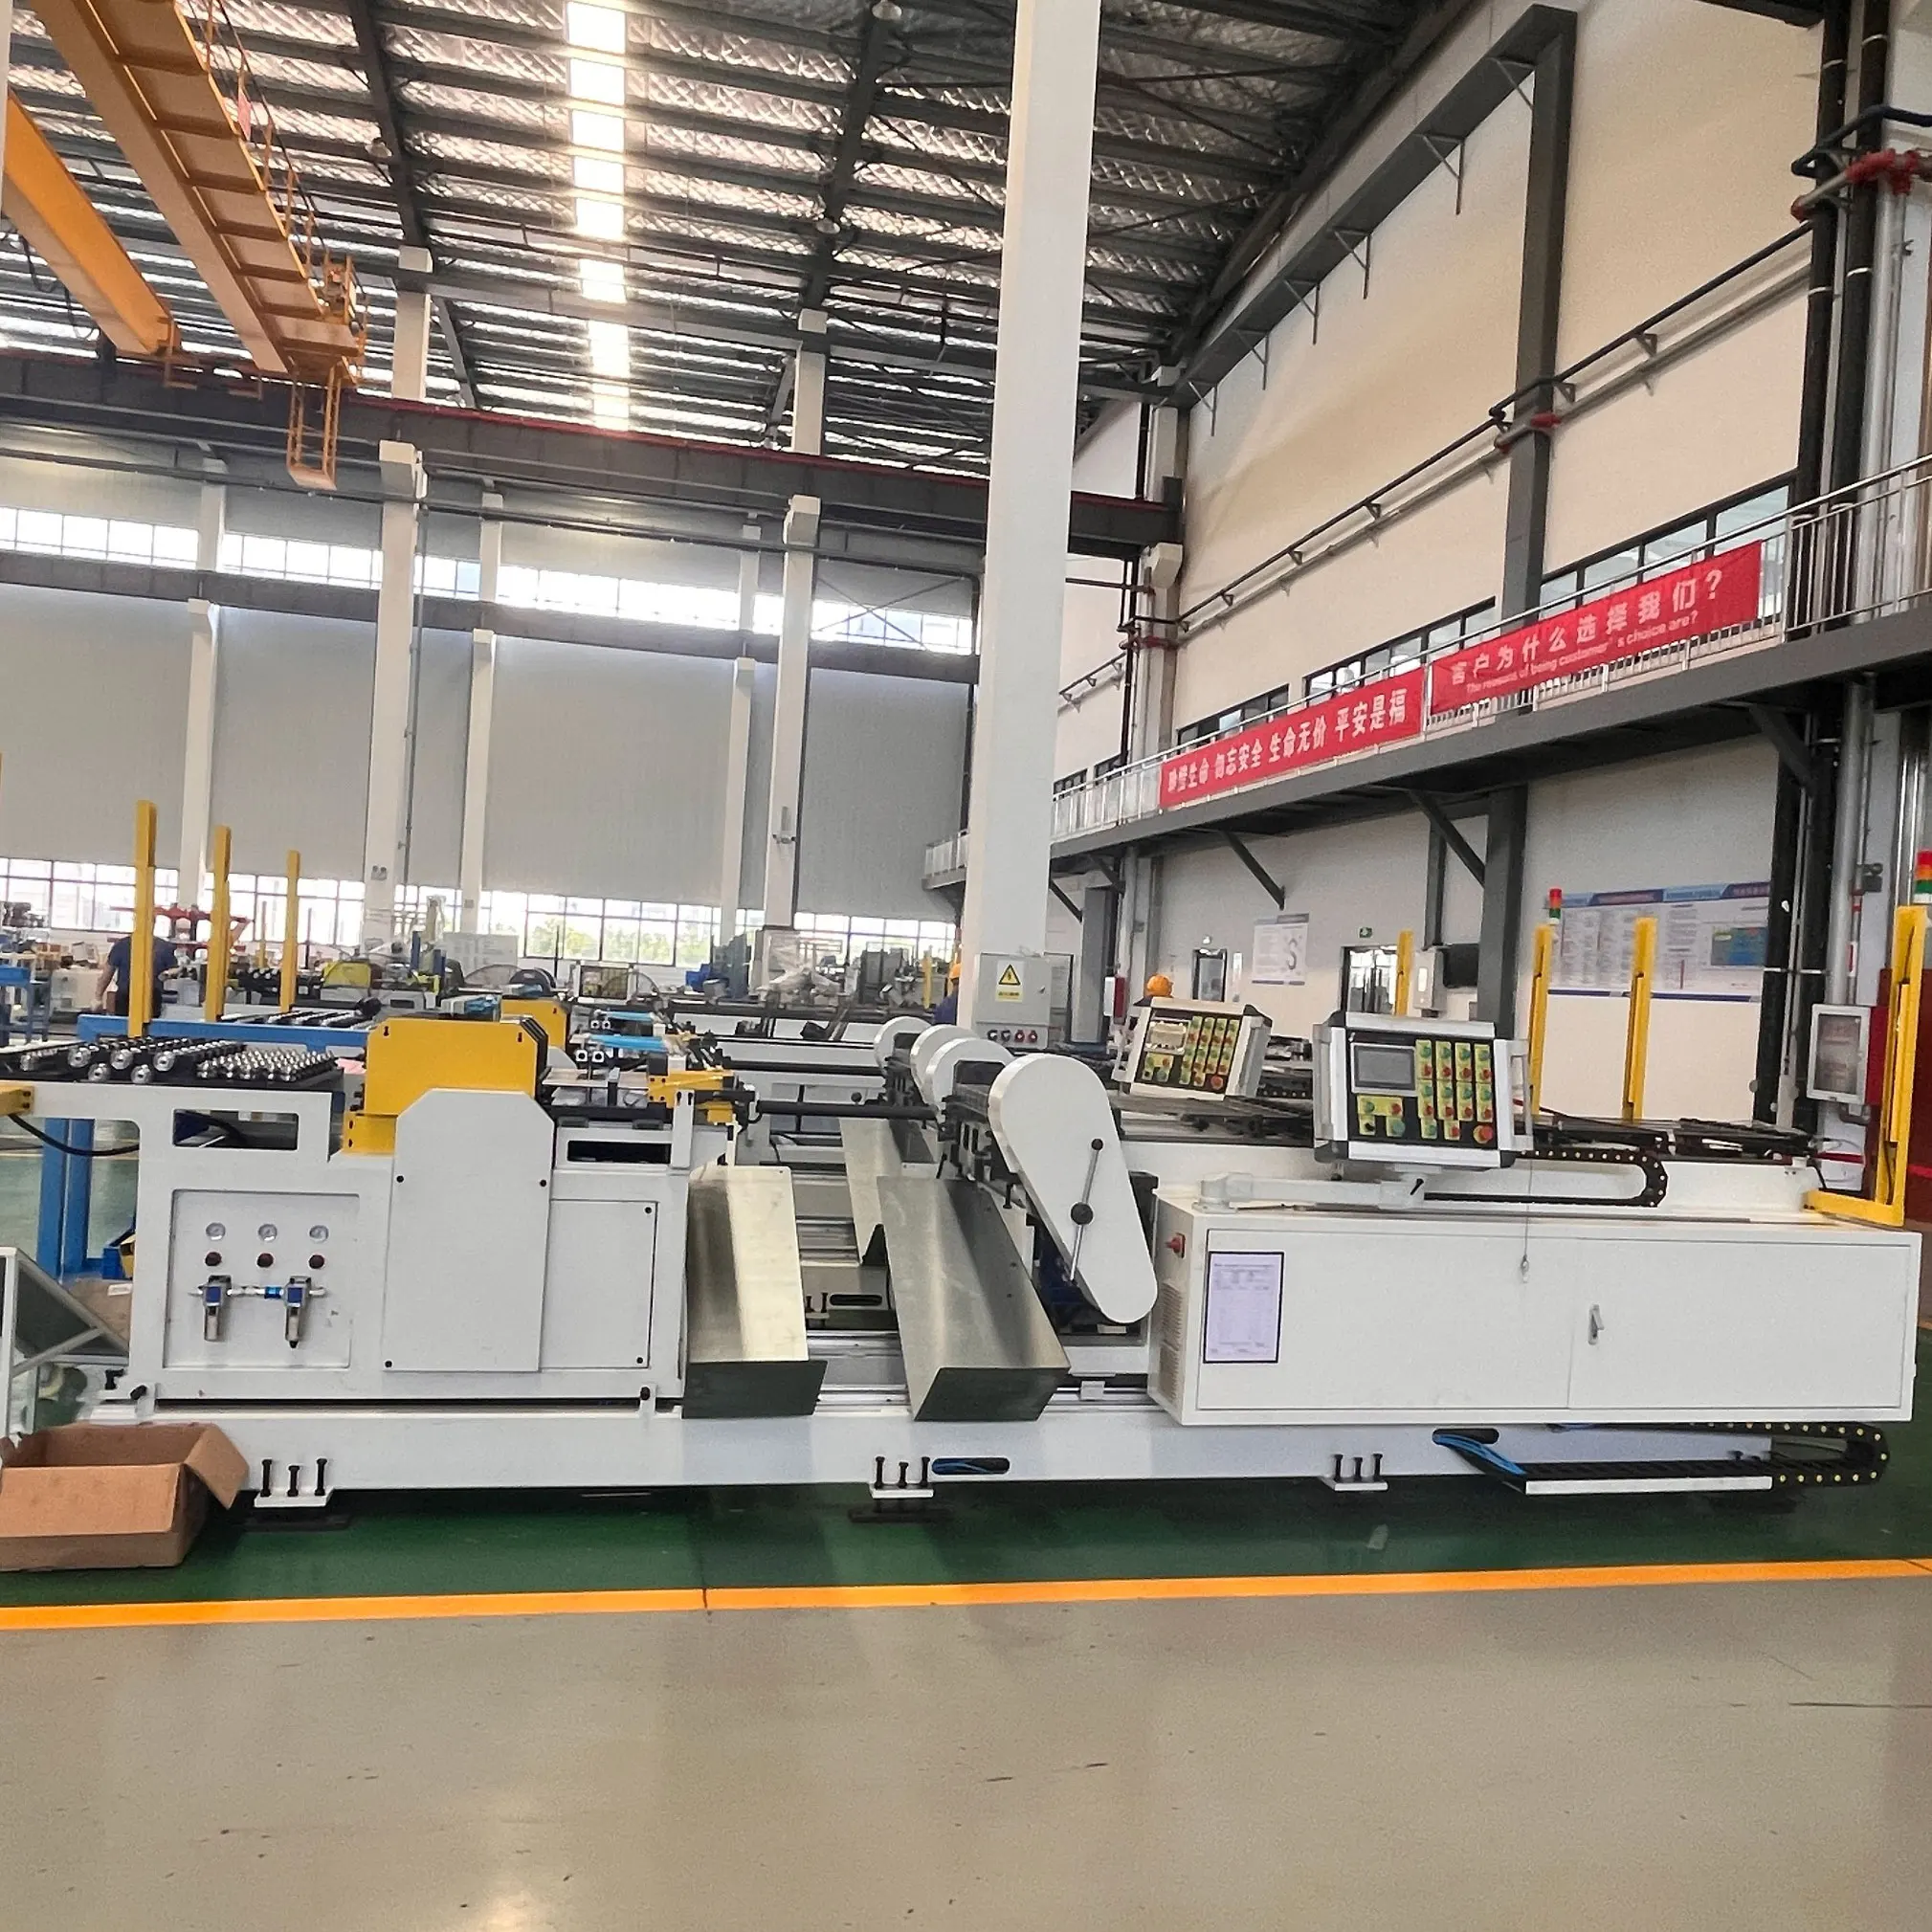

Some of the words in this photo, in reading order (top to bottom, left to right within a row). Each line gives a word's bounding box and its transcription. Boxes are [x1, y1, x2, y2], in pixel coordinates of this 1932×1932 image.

[1627, 623, 1667, 644] choice
[1268, 715, 1327, 764] 生命无价
[1335, 688, 1408, 743] 平安是福
